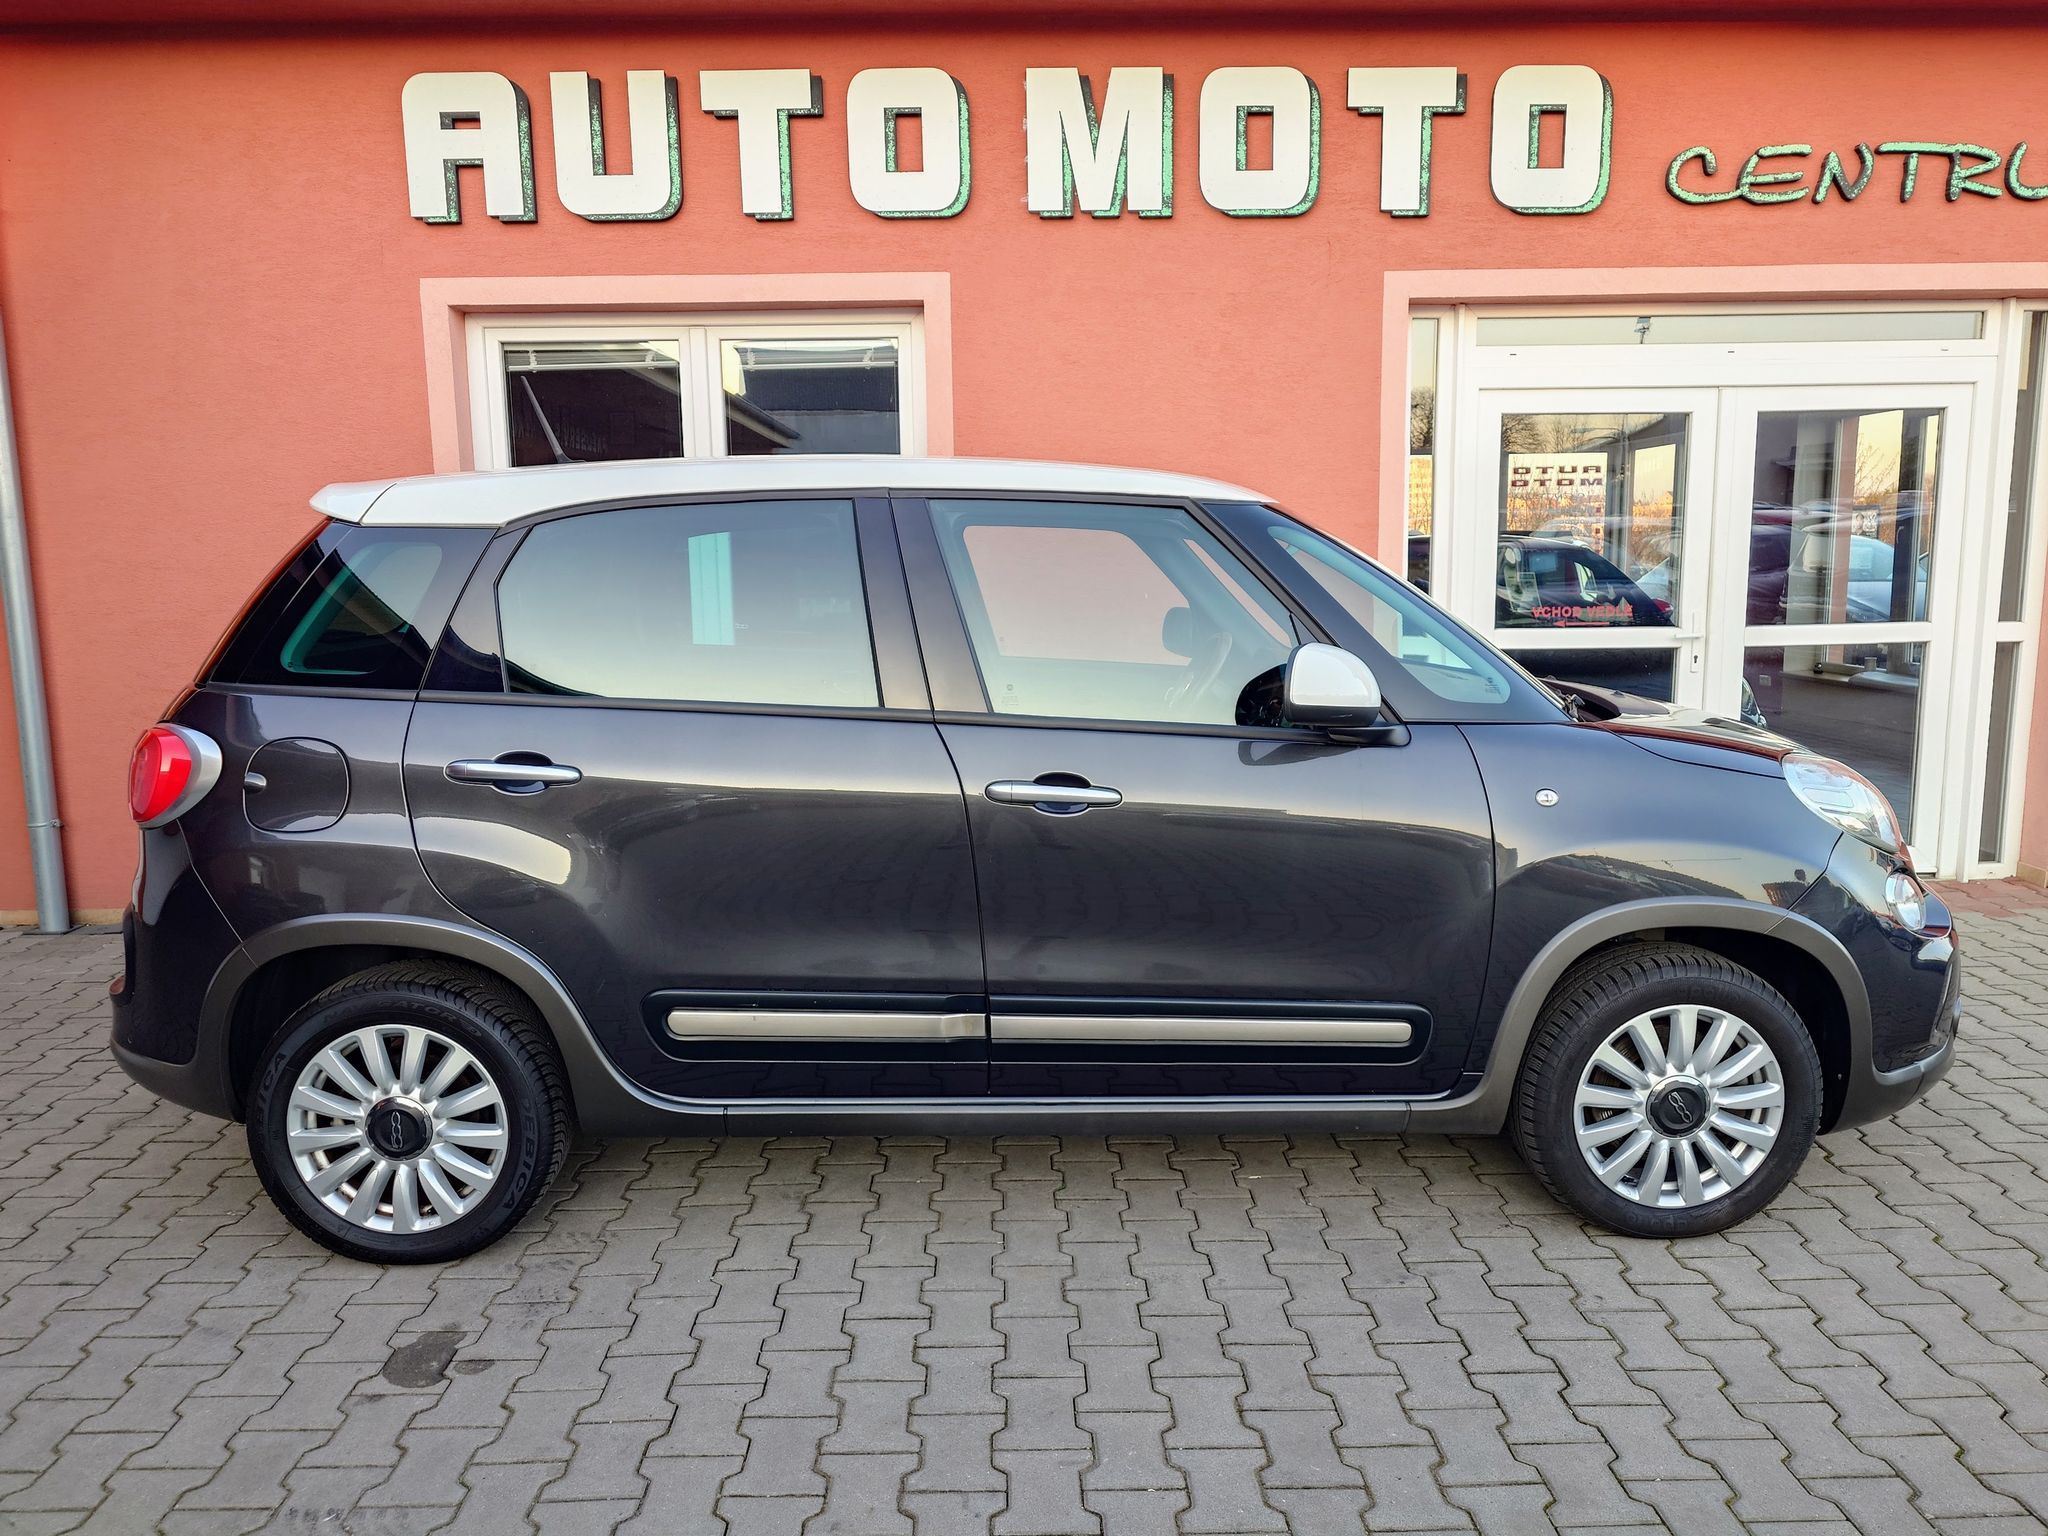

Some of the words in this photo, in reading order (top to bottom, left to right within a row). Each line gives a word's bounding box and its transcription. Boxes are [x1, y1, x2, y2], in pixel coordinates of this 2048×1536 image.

[401, 67, 972, 223] AUTO
[1024, 64, 1613, 218] MOTO
[1532, 606, 1582, 618] VCHOD
